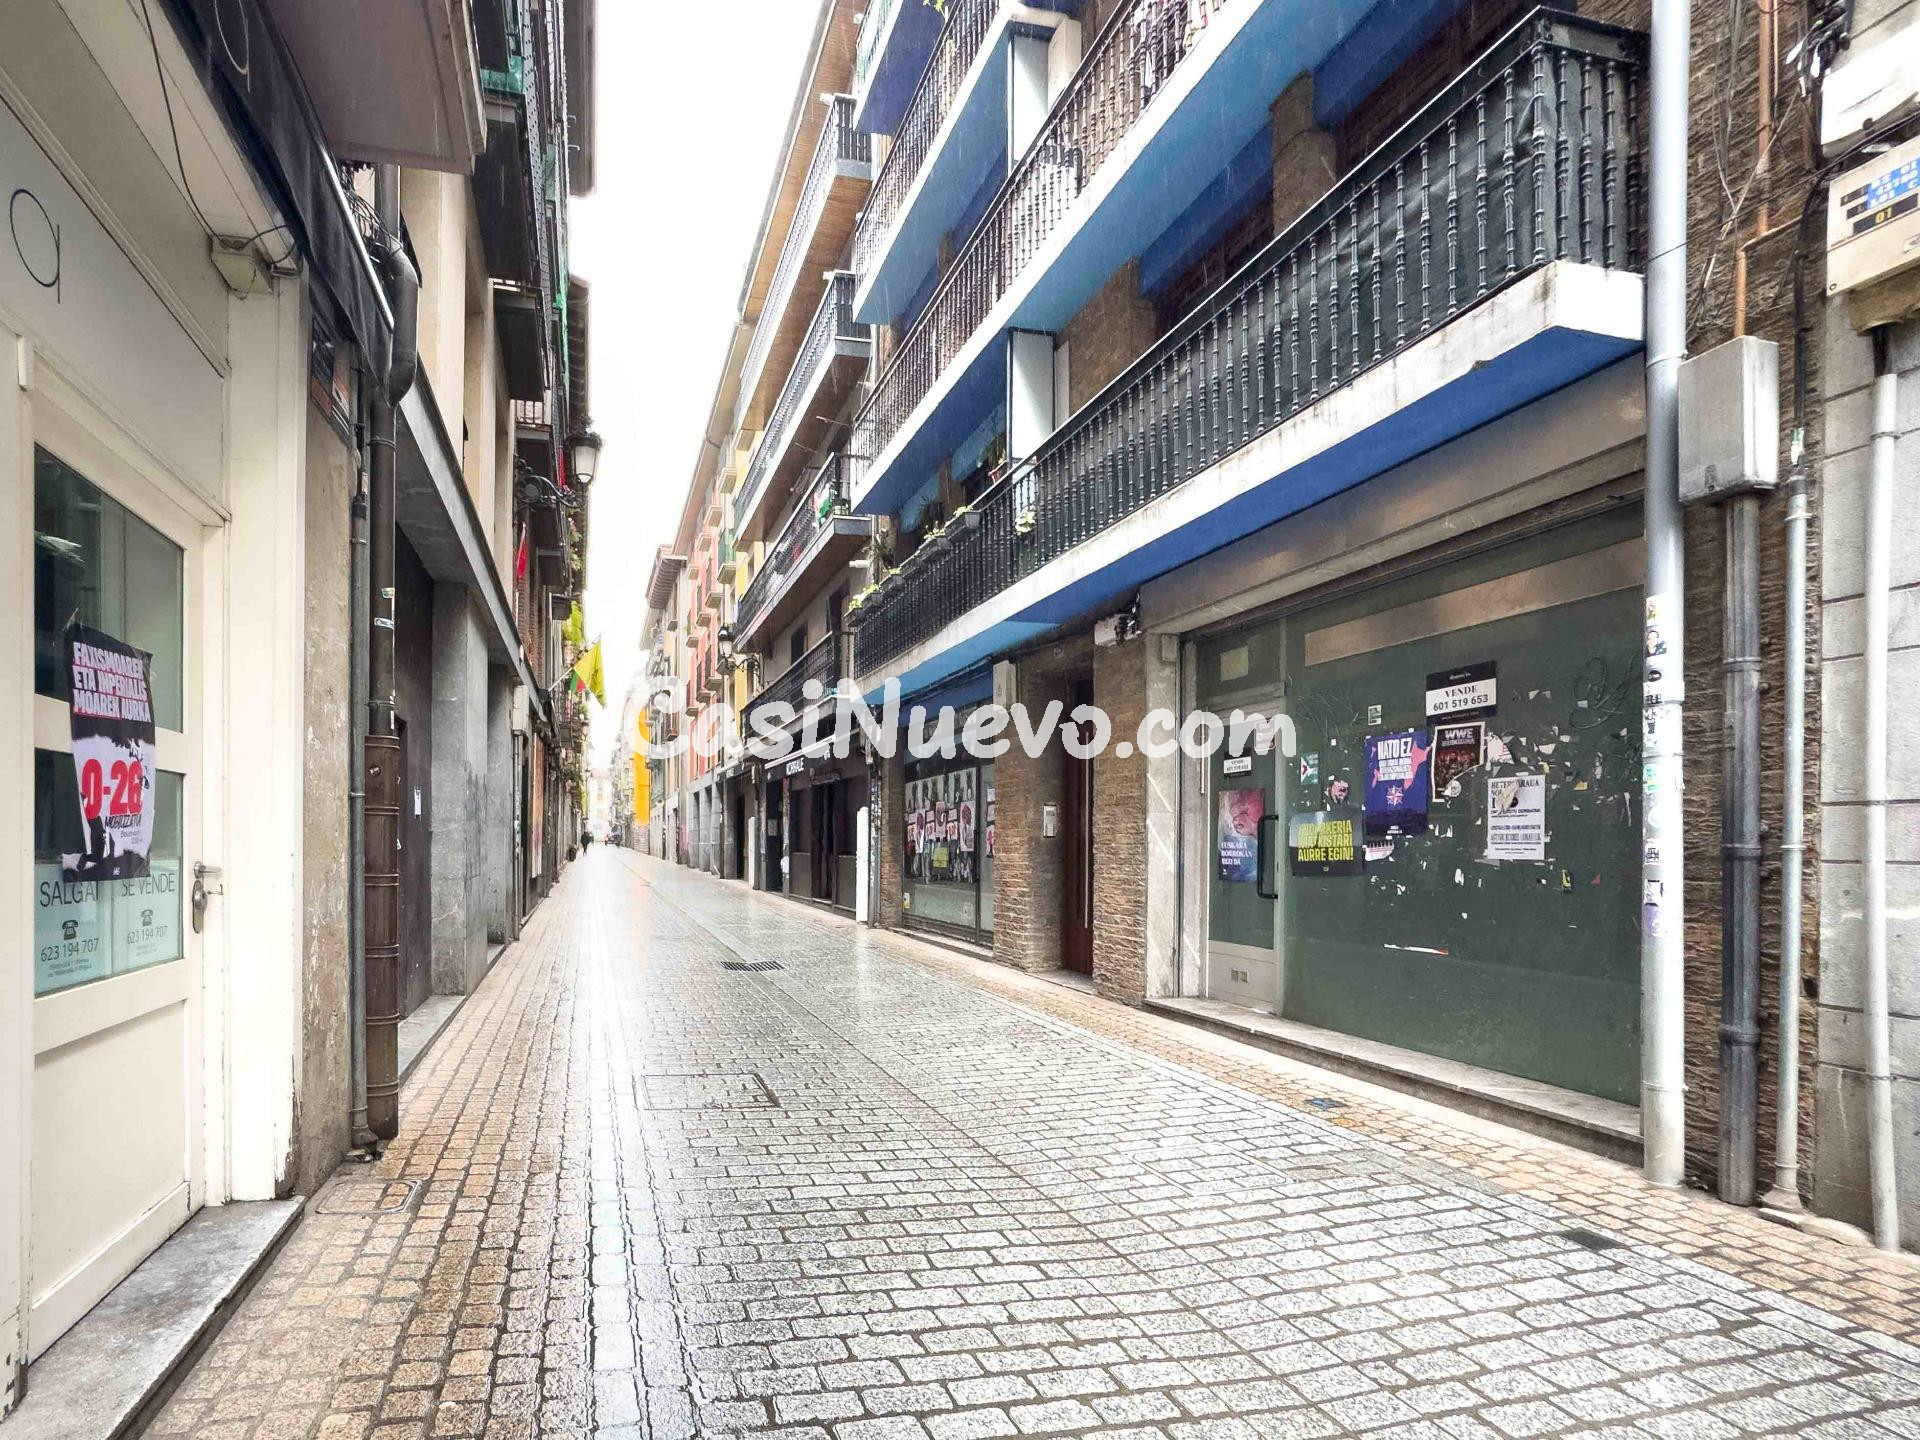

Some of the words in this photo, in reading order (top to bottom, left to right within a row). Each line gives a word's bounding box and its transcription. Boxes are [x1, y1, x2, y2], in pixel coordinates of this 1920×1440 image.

[72, 665, 97, 692] ETA
[1445, 685, 1479, 698] VENDE
[73, 688, 121, 718] MOAREN
[121, 698, 152, 723] AURKA
[1433, 701, 1449, 712] 601
[1452, 697, 1469, 709] 519
[1471, 694, 1489, 705] 653
[1444, 728, 1474, 741] WWE
[1377, 739, 1400, 760] NATO
[1400, 737, 1413, 757] EZ
[1298, 848, 1326, 862] AURRE
[1328, 846, 1354, 861] EGIN!
[121, 879, 136, 898] SE
[137, 873, 176, 897] VENDE
[128, 930, 140, 945] 623
[141, 928, 154, 942] 194
[155, 925, 168, 939] 707
[41, 945, 60, 962] 623
[63, 943, 80, 958] 194
[82, 938, 99, 954] 707
